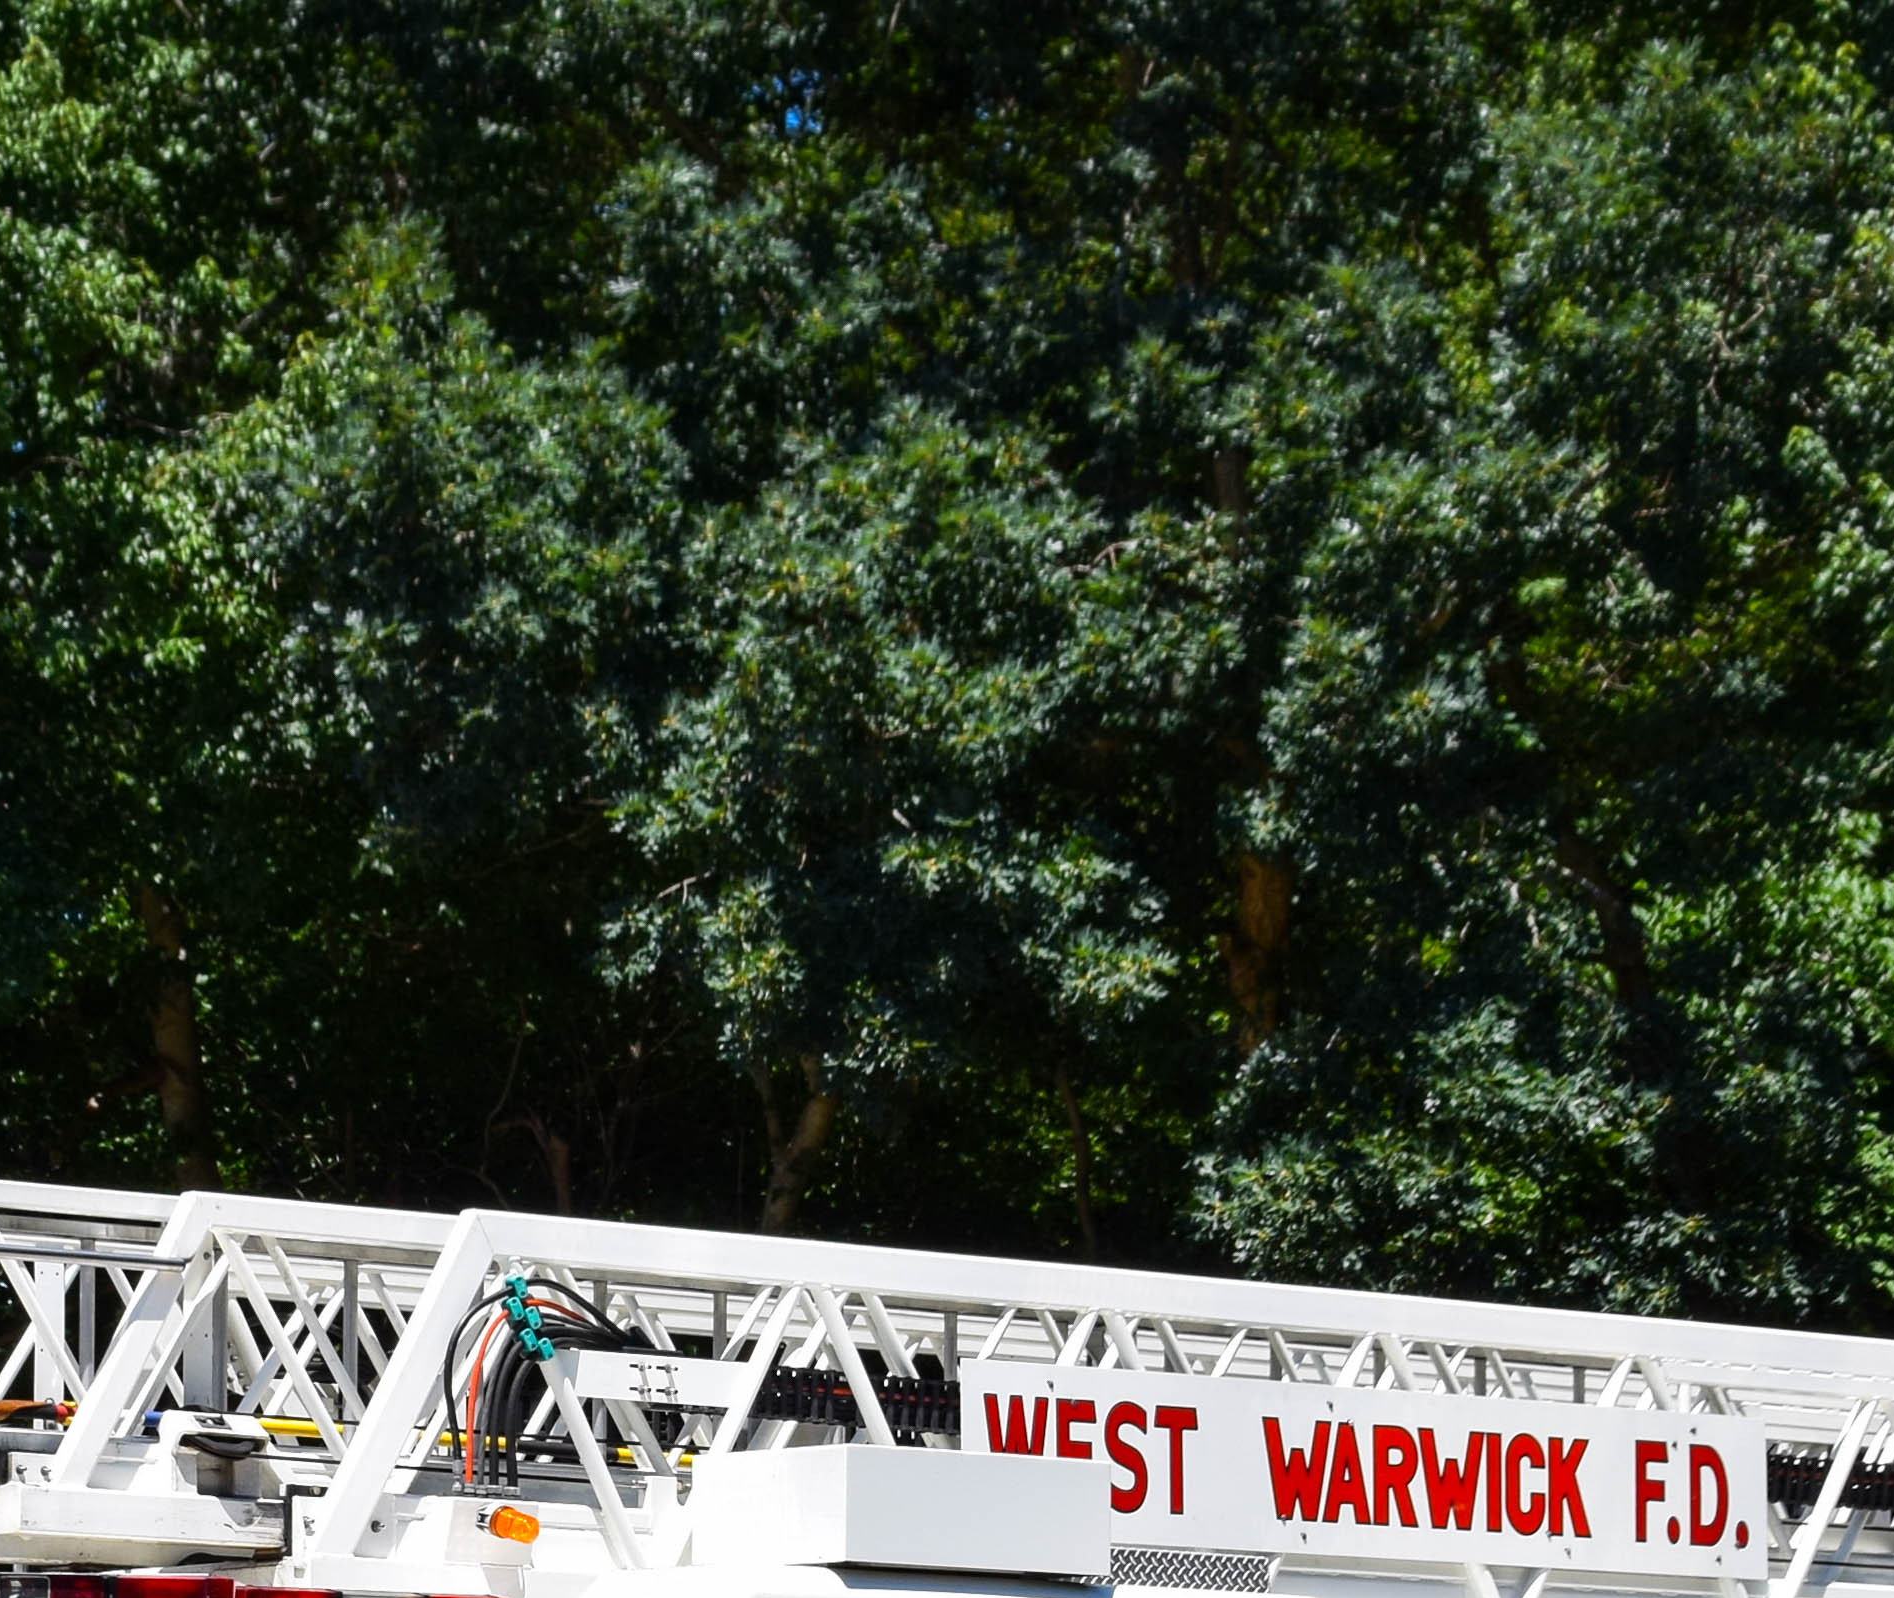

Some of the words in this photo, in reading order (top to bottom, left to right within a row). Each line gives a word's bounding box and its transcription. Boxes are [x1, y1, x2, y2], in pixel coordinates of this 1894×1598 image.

[983, 1393, 1198, 1515] WEST
[1261, 1415, 1592, 1539] WARWICK
[1635, 1440, 1750, 1549] F.D.
